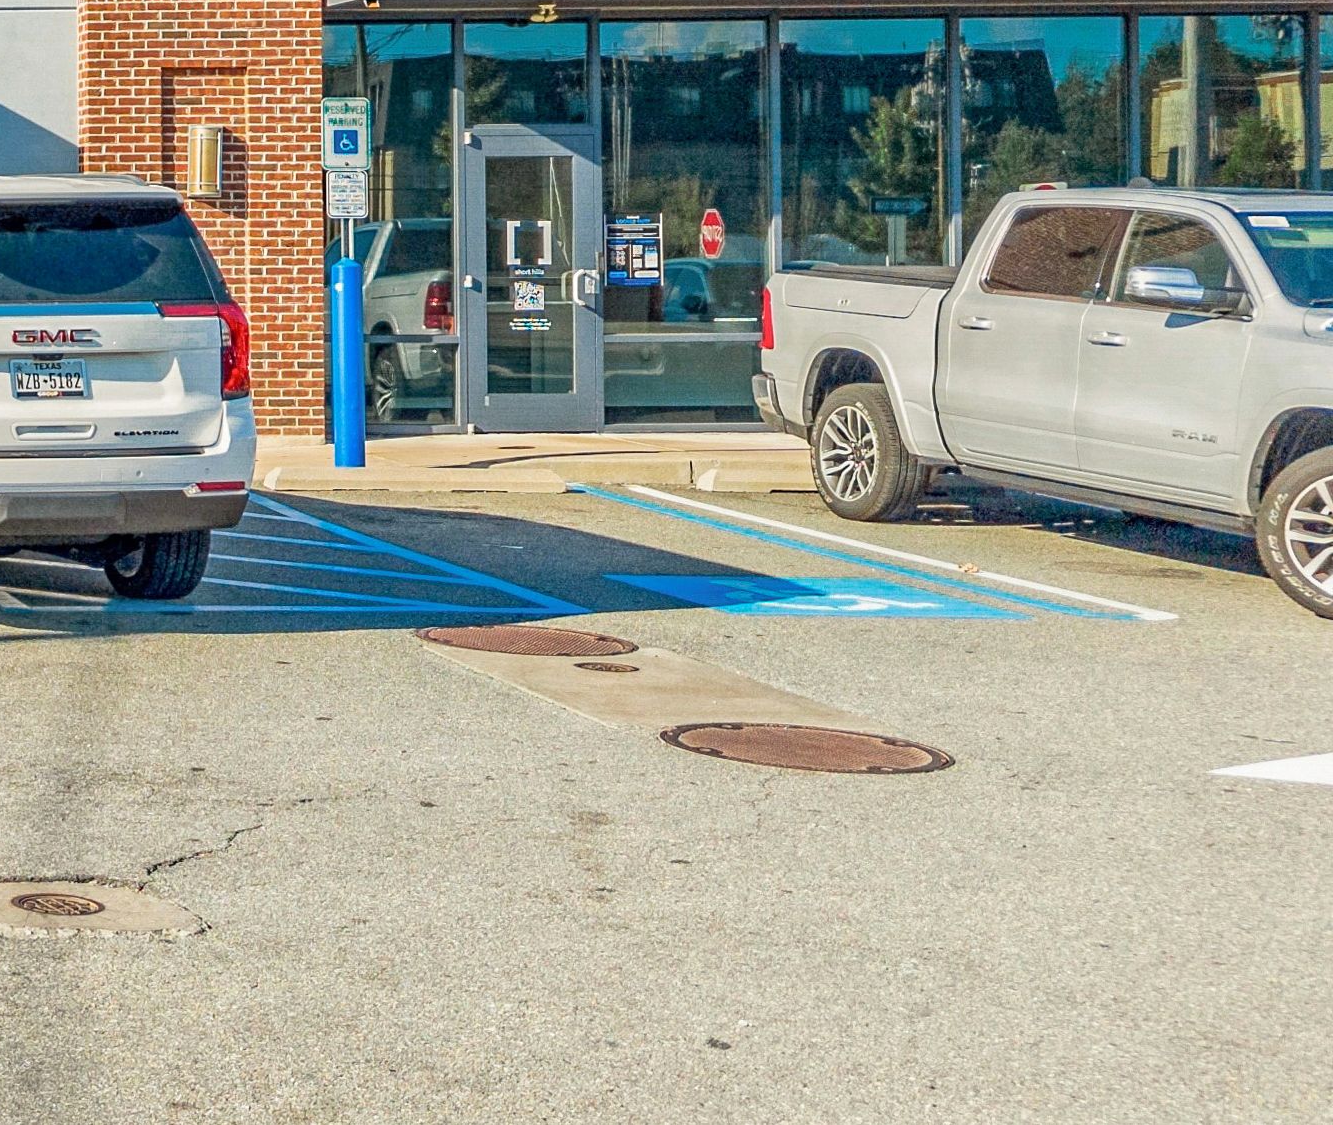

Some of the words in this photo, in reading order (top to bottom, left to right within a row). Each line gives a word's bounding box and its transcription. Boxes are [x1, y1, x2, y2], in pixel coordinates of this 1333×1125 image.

[324, 105, 366, 115] RESERVED
[328, 117, 364, 127] PARKING
[12, 329, 95, 343] GMC
[34, 362, 62, 370] TEXAS
